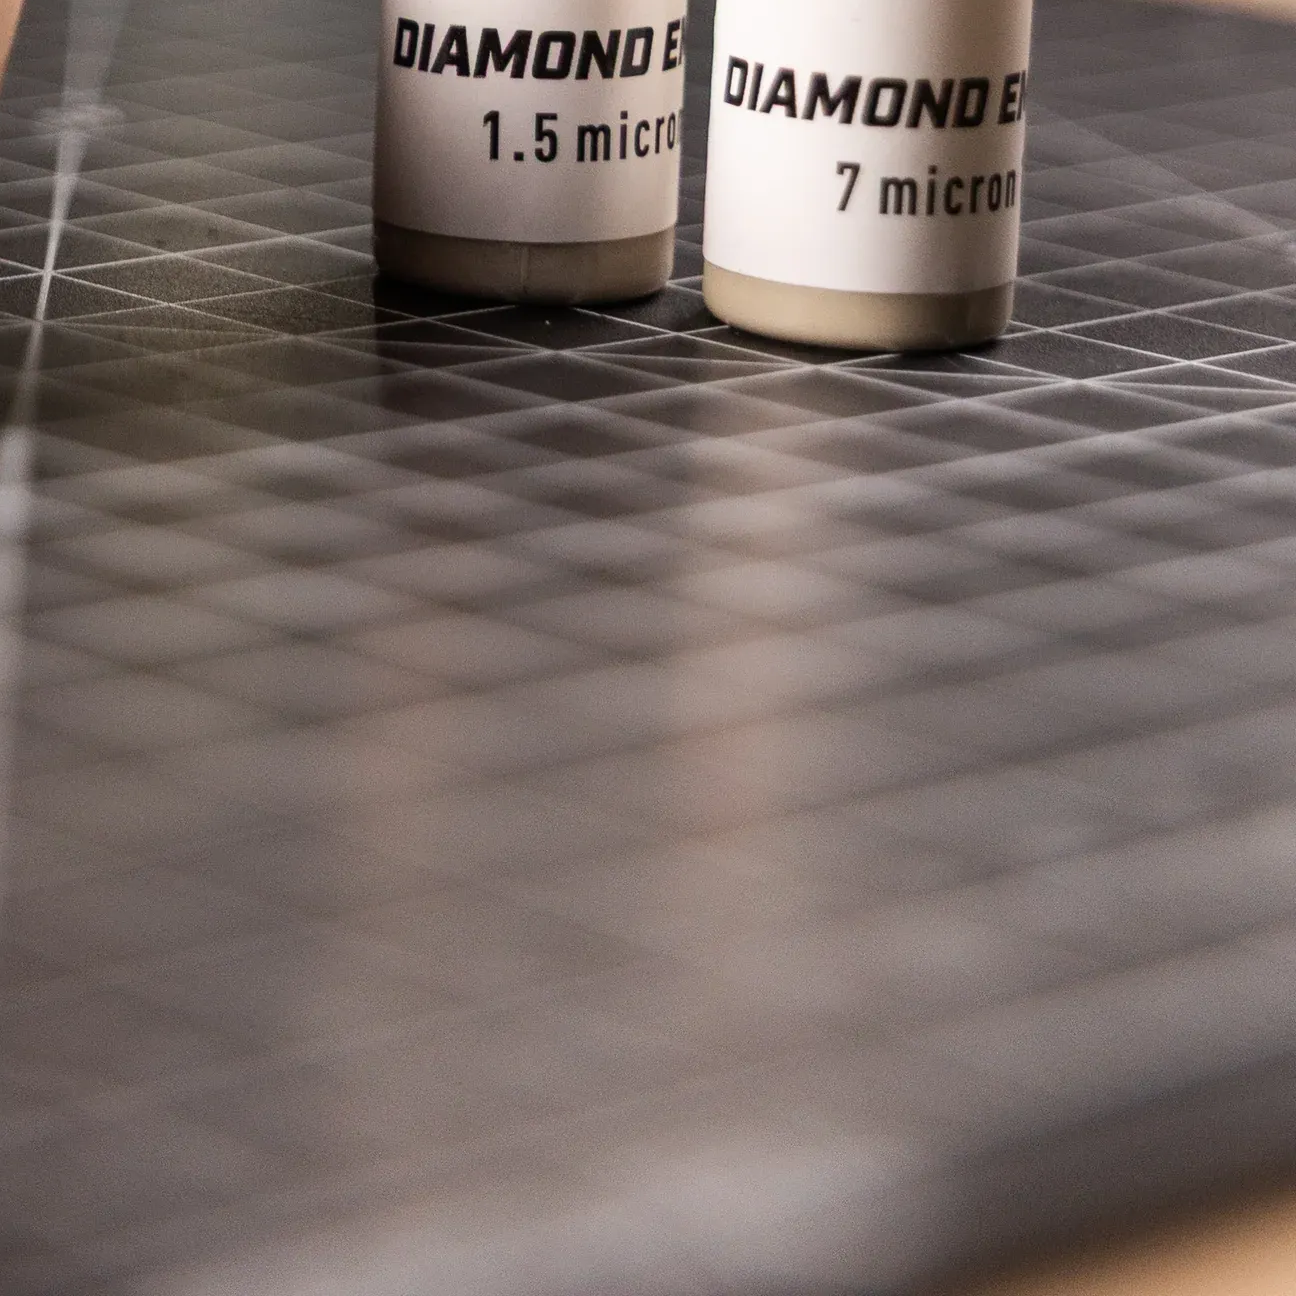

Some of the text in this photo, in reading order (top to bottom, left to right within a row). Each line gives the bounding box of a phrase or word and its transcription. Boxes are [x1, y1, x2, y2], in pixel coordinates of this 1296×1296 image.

[394, 16, 686, 80] DIAMOND E
[723, 56, 990, 129] DIAMOND
[483, 110, 680, 163] 1.5 micro
[836, 161, 1016, 216] 7 micron
